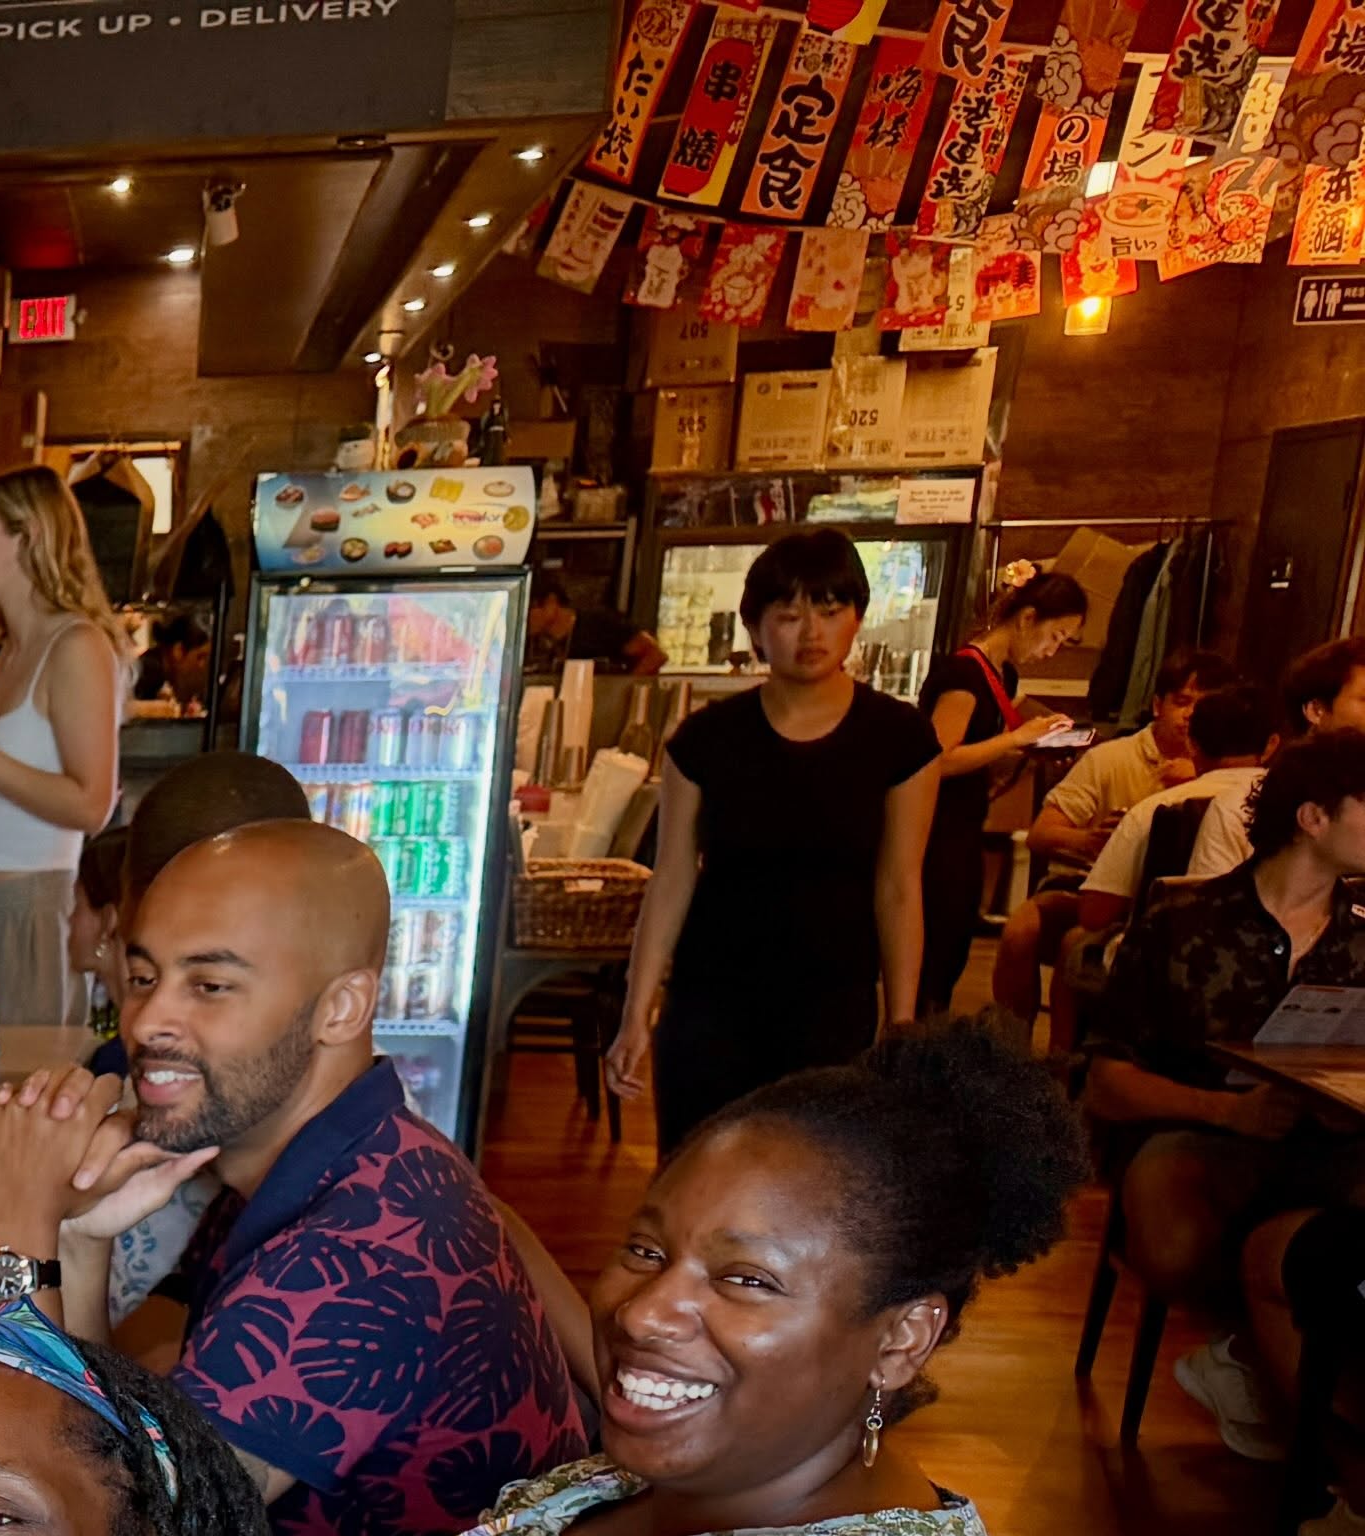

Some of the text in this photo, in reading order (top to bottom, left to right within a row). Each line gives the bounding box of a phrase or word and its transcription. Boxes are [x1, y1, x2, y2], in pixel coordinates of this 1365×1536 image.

[98, 13, 153, 37] UP
[199, 0, 398, 29] DELIVERY
[758, 73, 837, 210] 定食
[19, 296, 69, 340] EXIT
[848, 408, 880, 427] 520
